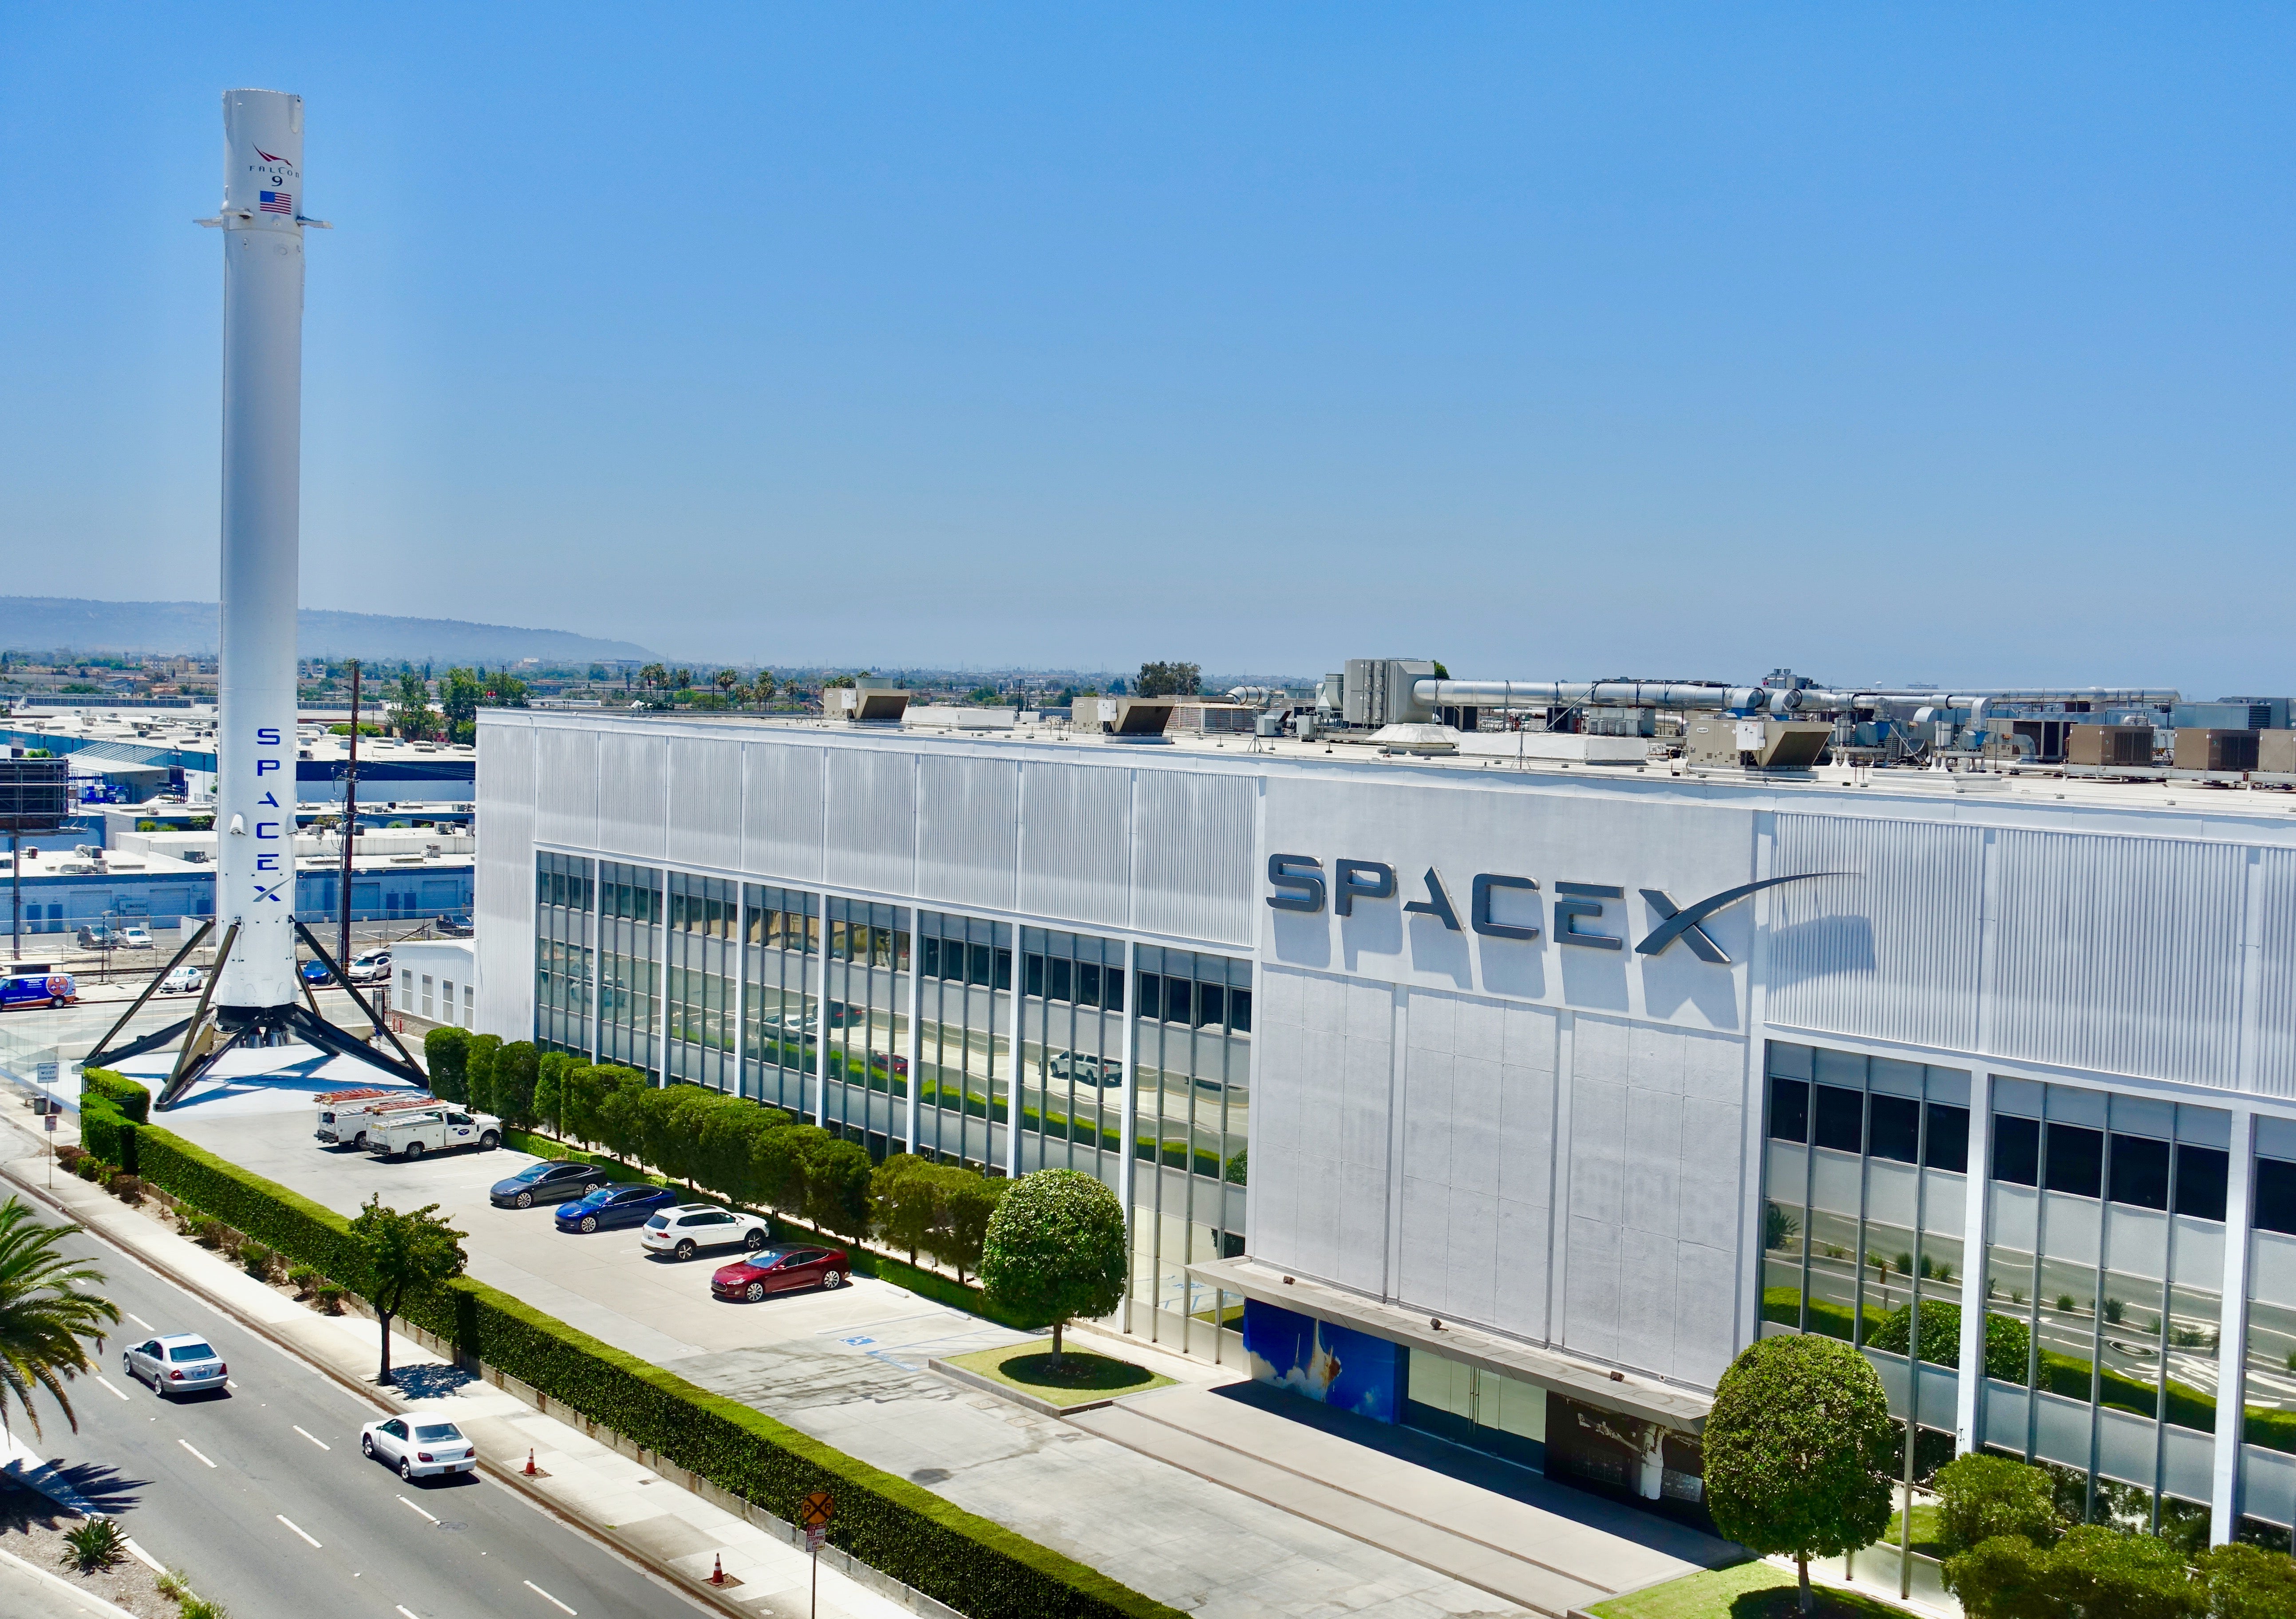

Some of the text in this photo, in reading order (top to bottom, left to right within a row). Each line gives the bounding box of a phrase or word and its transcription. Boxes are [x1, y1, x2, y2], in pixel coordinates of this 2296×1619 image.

[249, 166, 299, 178] FALCON
[271, 176, 283, 186] 9
[253, 728, 293, 902] SPACEX
[1266, 853, 1863, 964] SPACEX
